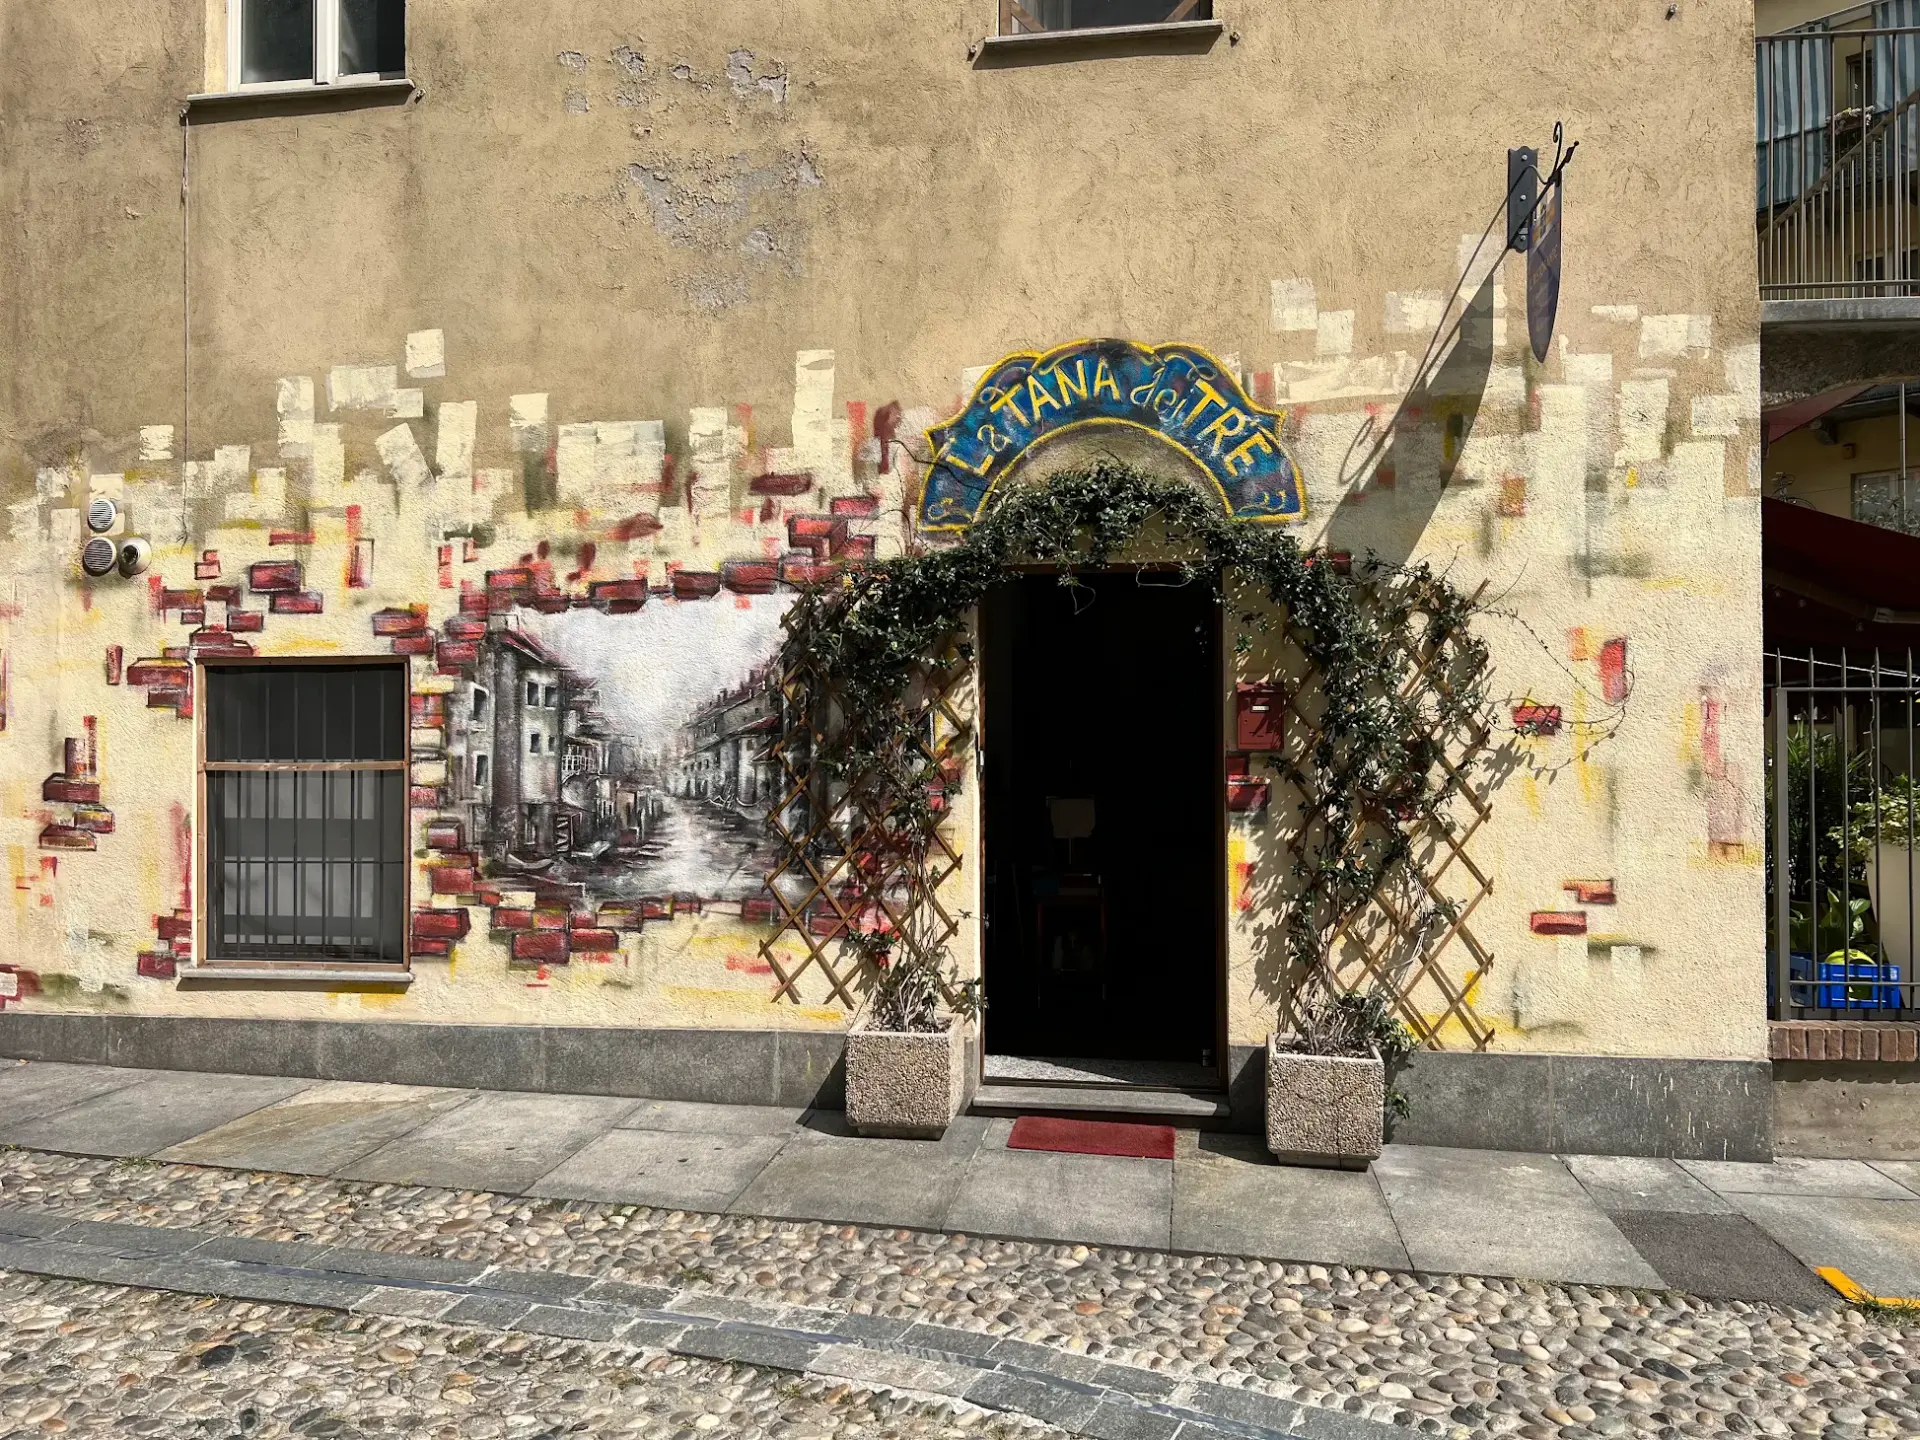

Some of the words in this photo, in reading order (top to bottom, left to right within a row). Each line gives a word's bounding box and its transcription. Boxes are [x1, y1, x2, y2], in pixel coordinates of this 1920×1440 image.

[989, 356, 1121, 428] TANA
[1130, 366, 1195, 420] dei
[1181, 378, 1273, 478] TRE
